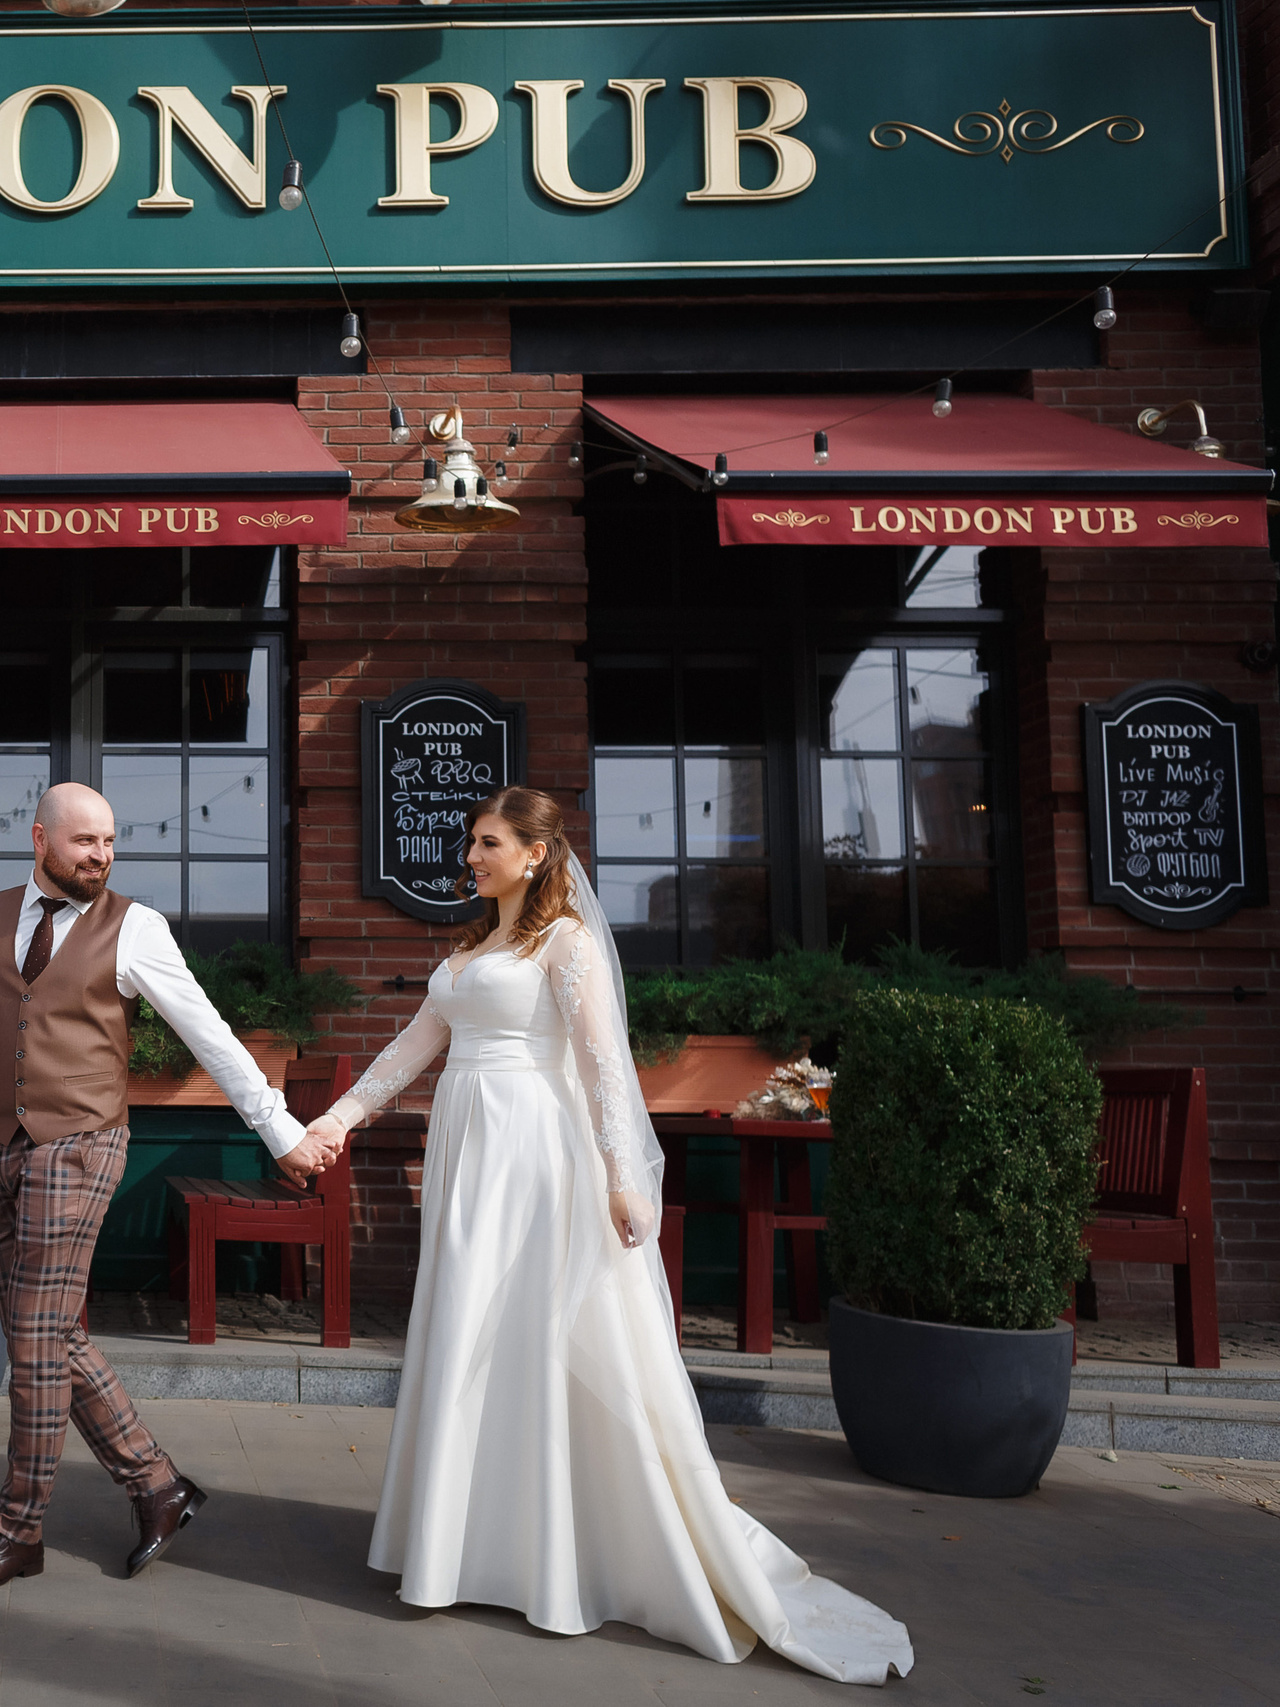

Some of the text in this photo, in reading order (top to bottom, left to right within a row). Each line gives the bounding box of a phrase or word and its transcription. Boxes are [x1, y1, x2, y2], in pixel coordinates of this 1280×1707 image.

[377, 76, 817, 209] PUB
[138, 507, 220, 534] PUB
[850, 506, 1139, 535] LONDON PUB
[401, 721, 484, 737] LONDON
[1126, 723, 1212, 739] LONDON
[423, 741, 463, 757] PUB
[1149, 744, 1191, 760] PUB
[430, 758, 497, 785] BBQ
[1119, 789, 1149, 807] DJ
[1122, 811, 1192, 827] BRITPOP
[1193, 828, 1225, 847] TV
[1157, 852, 1221, 878] ФУТБОЛ
